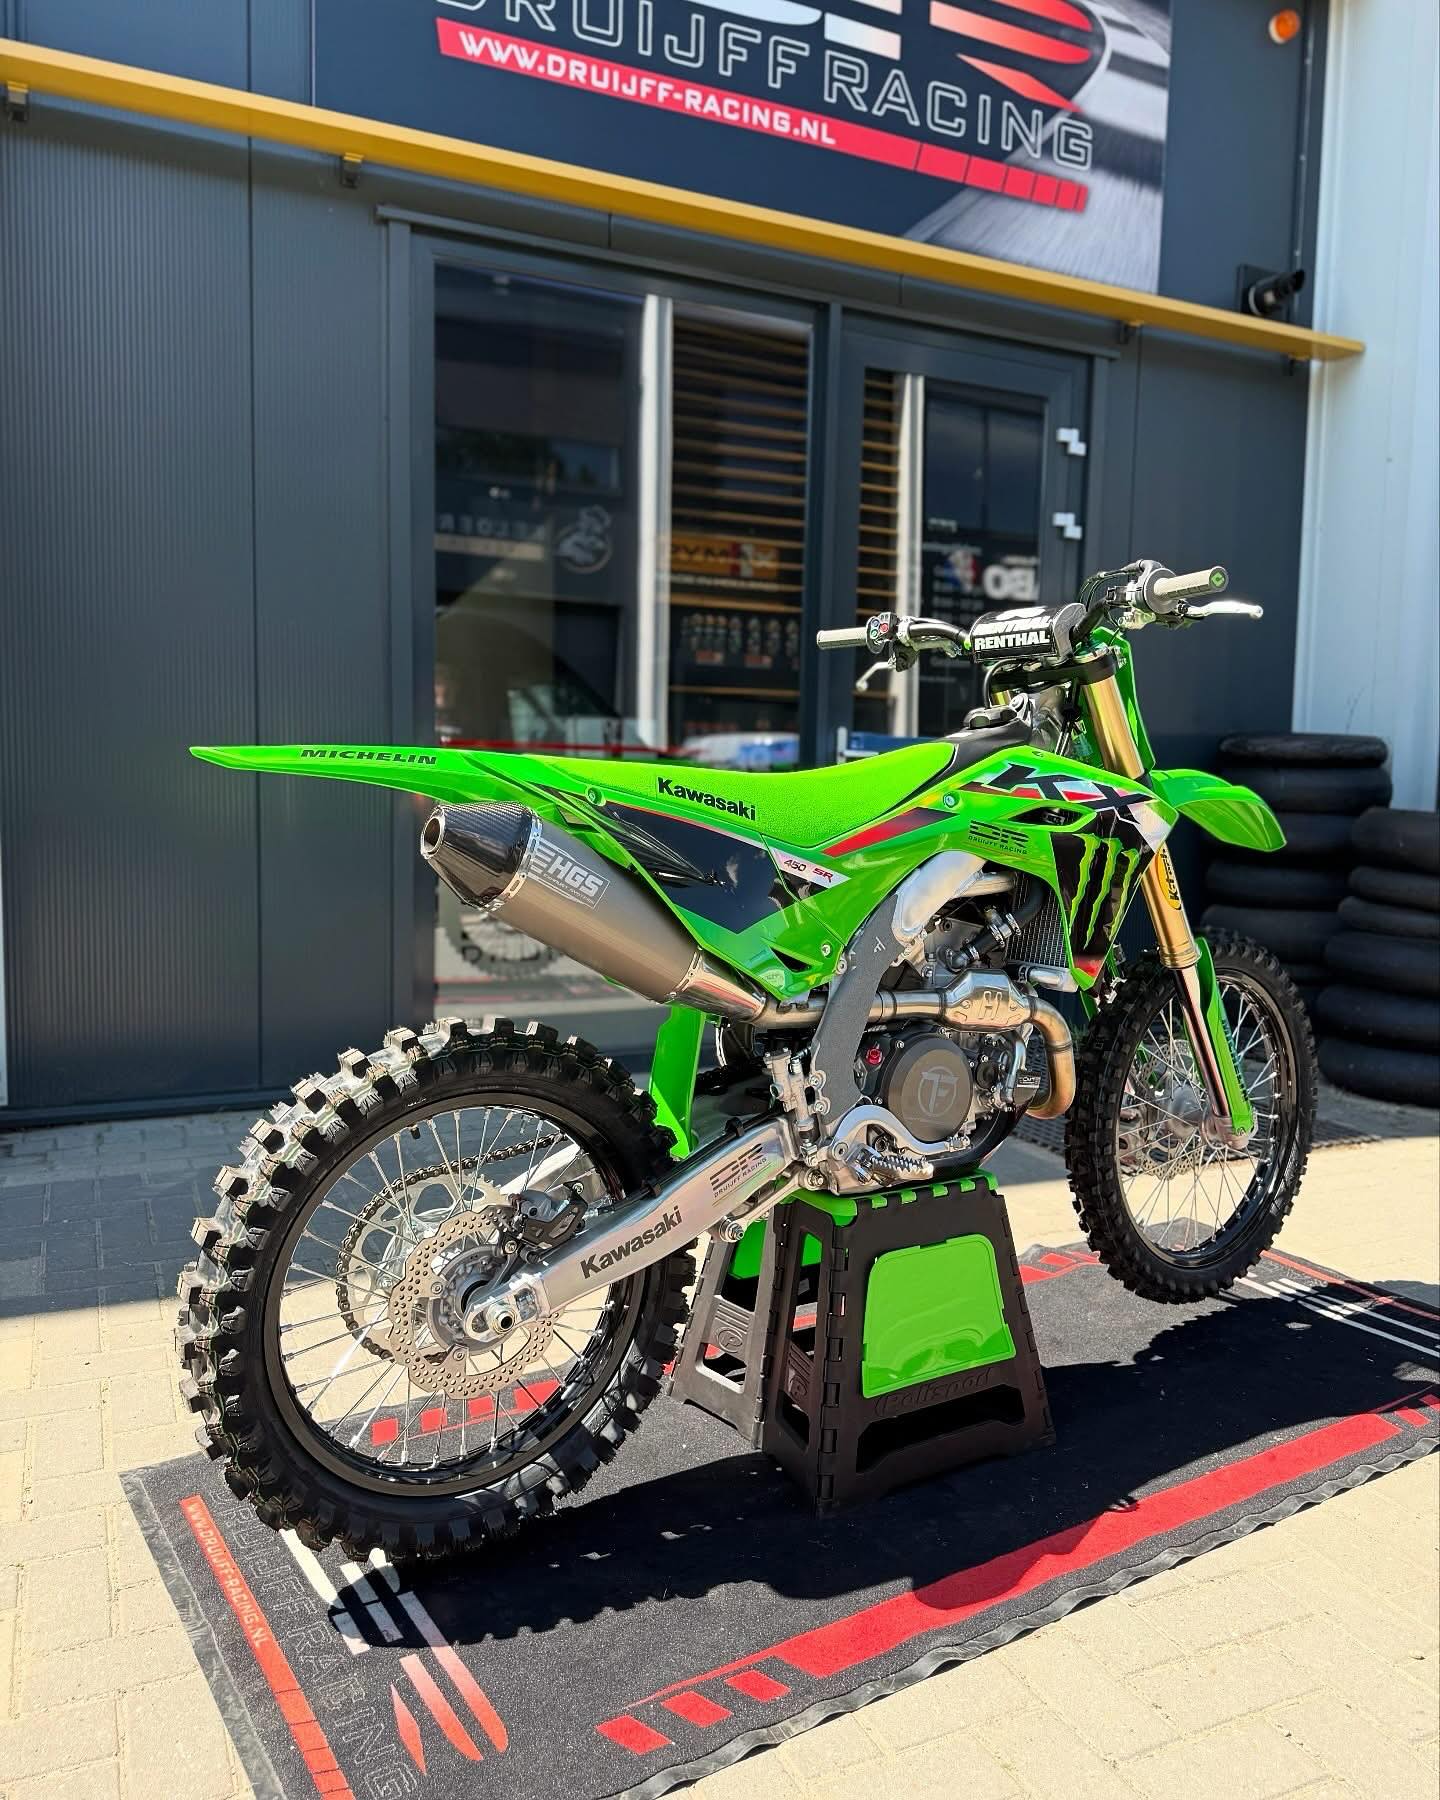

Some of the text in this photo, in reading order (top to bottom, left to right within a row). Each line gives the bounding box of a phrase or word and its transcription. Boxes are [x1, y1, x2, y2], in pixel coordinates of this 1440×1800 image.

[459, 31, 836, 146] WWW.DRUIJFF-RACING.NL
[974, 630, 1051, 651] RENTHAL
[300, 749, 437, 765] MICHELIN
[657, 776, 756, 821] Kawasaki
[547, 855, 604, 897] HGS
[783, 859, 834, 883] 450 SR
[580, 1205, 682, 1279] Kawasaki
